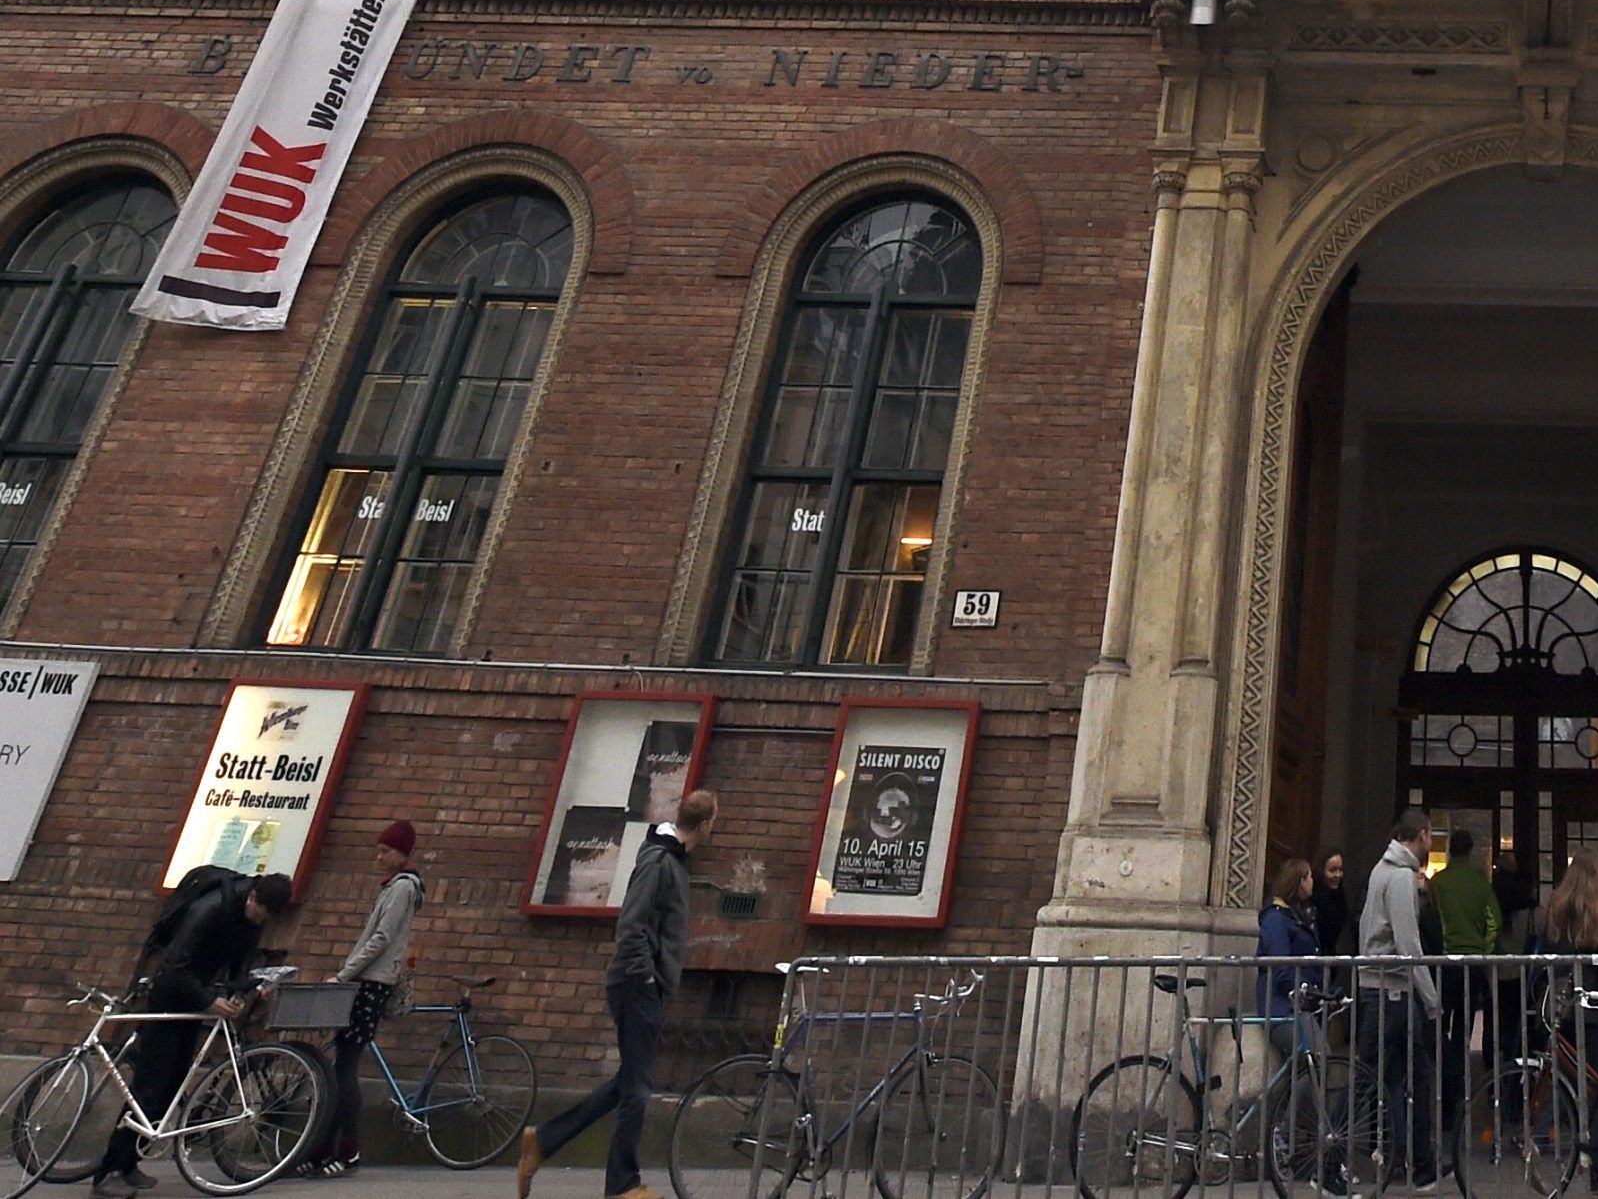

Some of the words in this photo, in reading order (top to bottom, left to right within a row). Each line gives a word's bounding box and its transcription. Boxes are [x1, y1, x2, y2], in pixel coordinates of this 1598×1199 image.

[187, 35, 651, 84] BÜNDET
[194, 126, 327, 273] WUK
[415, 498, 455, 522] Beisl
[963, 593, 991, 616] 59
[215, 752, 324, 782] Statt-Beisl
[858, 752, 901, 769] SILENT
[904, 754, 941, 770] DISCO
[204, 788, 311, 810] Café-Restaurant
[843, 837, 863, 855] 10.
[867, 838, 903, 859] April
[908, 840, 926, 858] 15
[840, 856, 863, 868] WUK
[864, 857, 886, 869] Wien
[906, 859, 922, 871] Uhr
